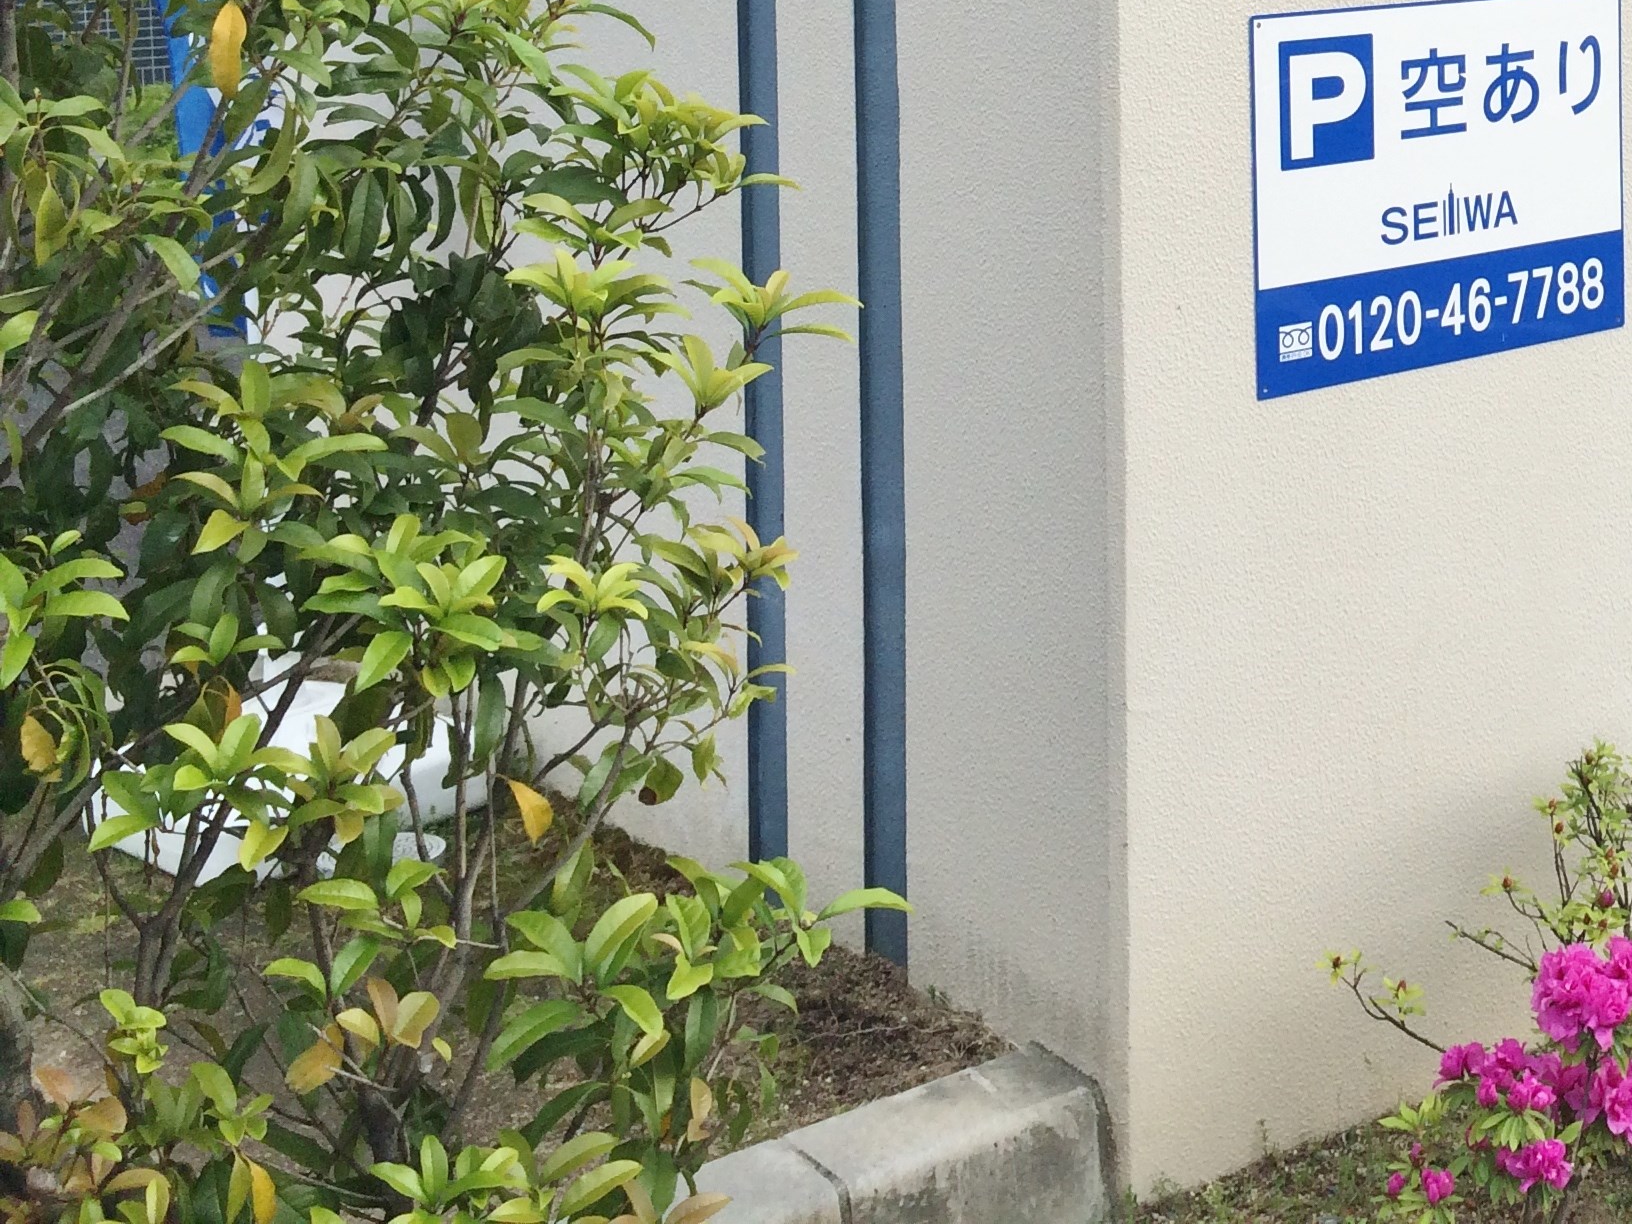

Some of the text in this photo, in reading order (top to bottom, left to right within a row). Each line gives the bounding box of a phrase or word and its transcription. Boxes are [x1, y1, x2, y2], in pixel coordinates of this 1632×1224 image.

[1288, 34, 1602, 161] P 空あり
[1318, 257, 1605, 361] 0120-46-7788
